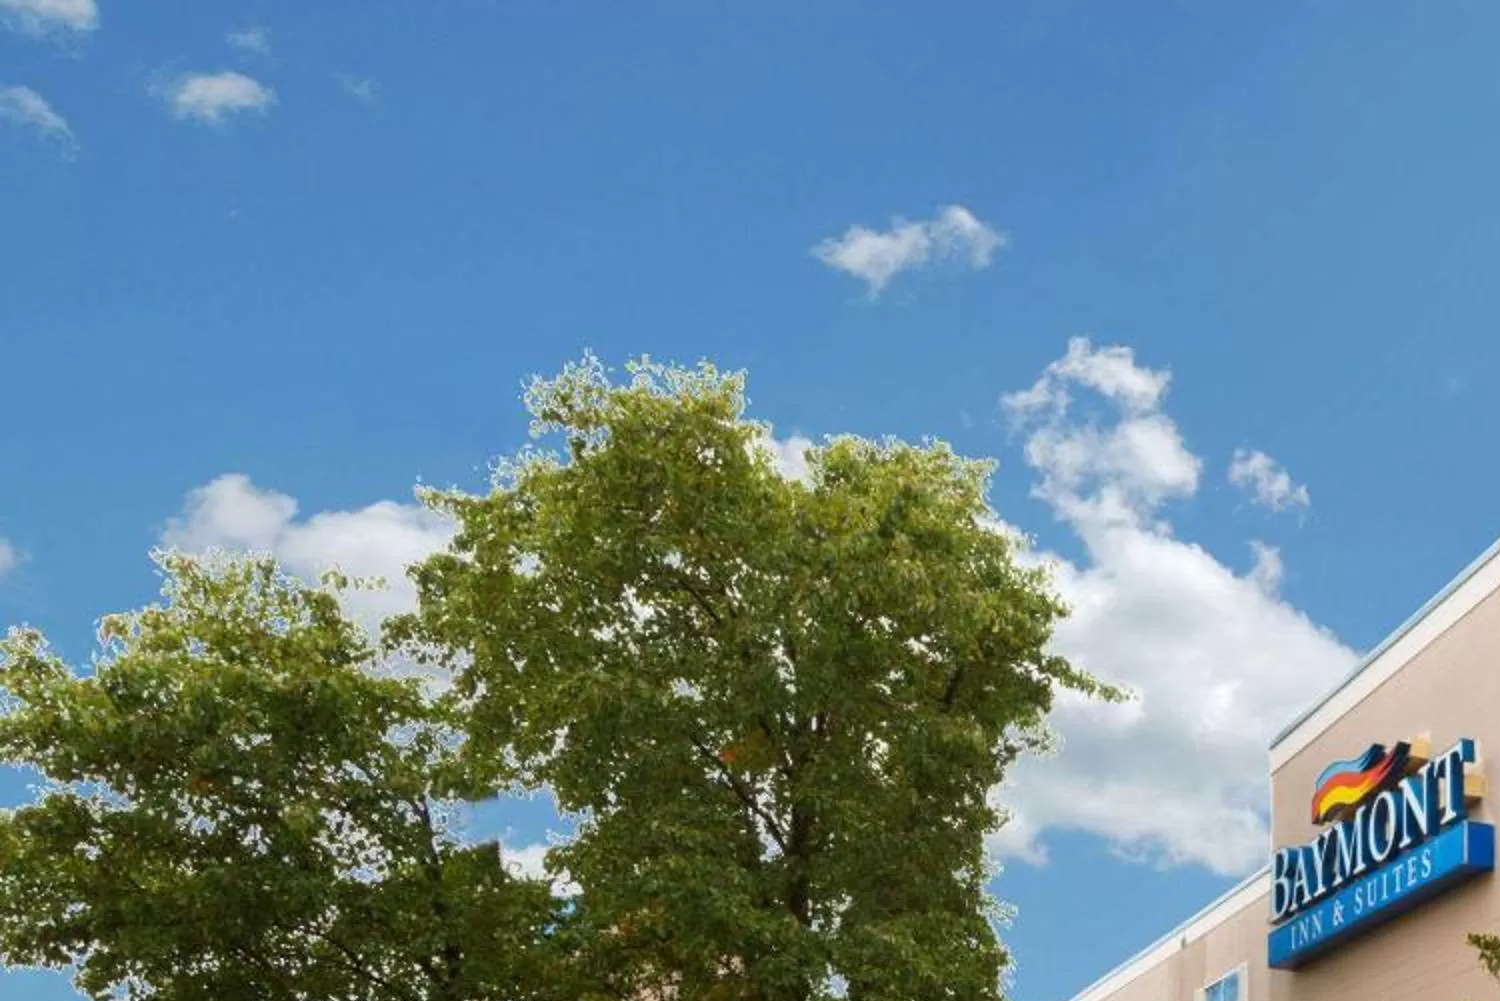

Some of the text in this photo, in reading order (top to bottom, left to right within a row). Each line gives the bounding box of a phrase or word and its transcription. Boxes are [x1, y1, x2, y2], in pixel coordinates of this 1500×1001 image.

[1271, 738, 1474, 919] BAYMONT
[1290, 848, 1432, 950] INN & SUITES
